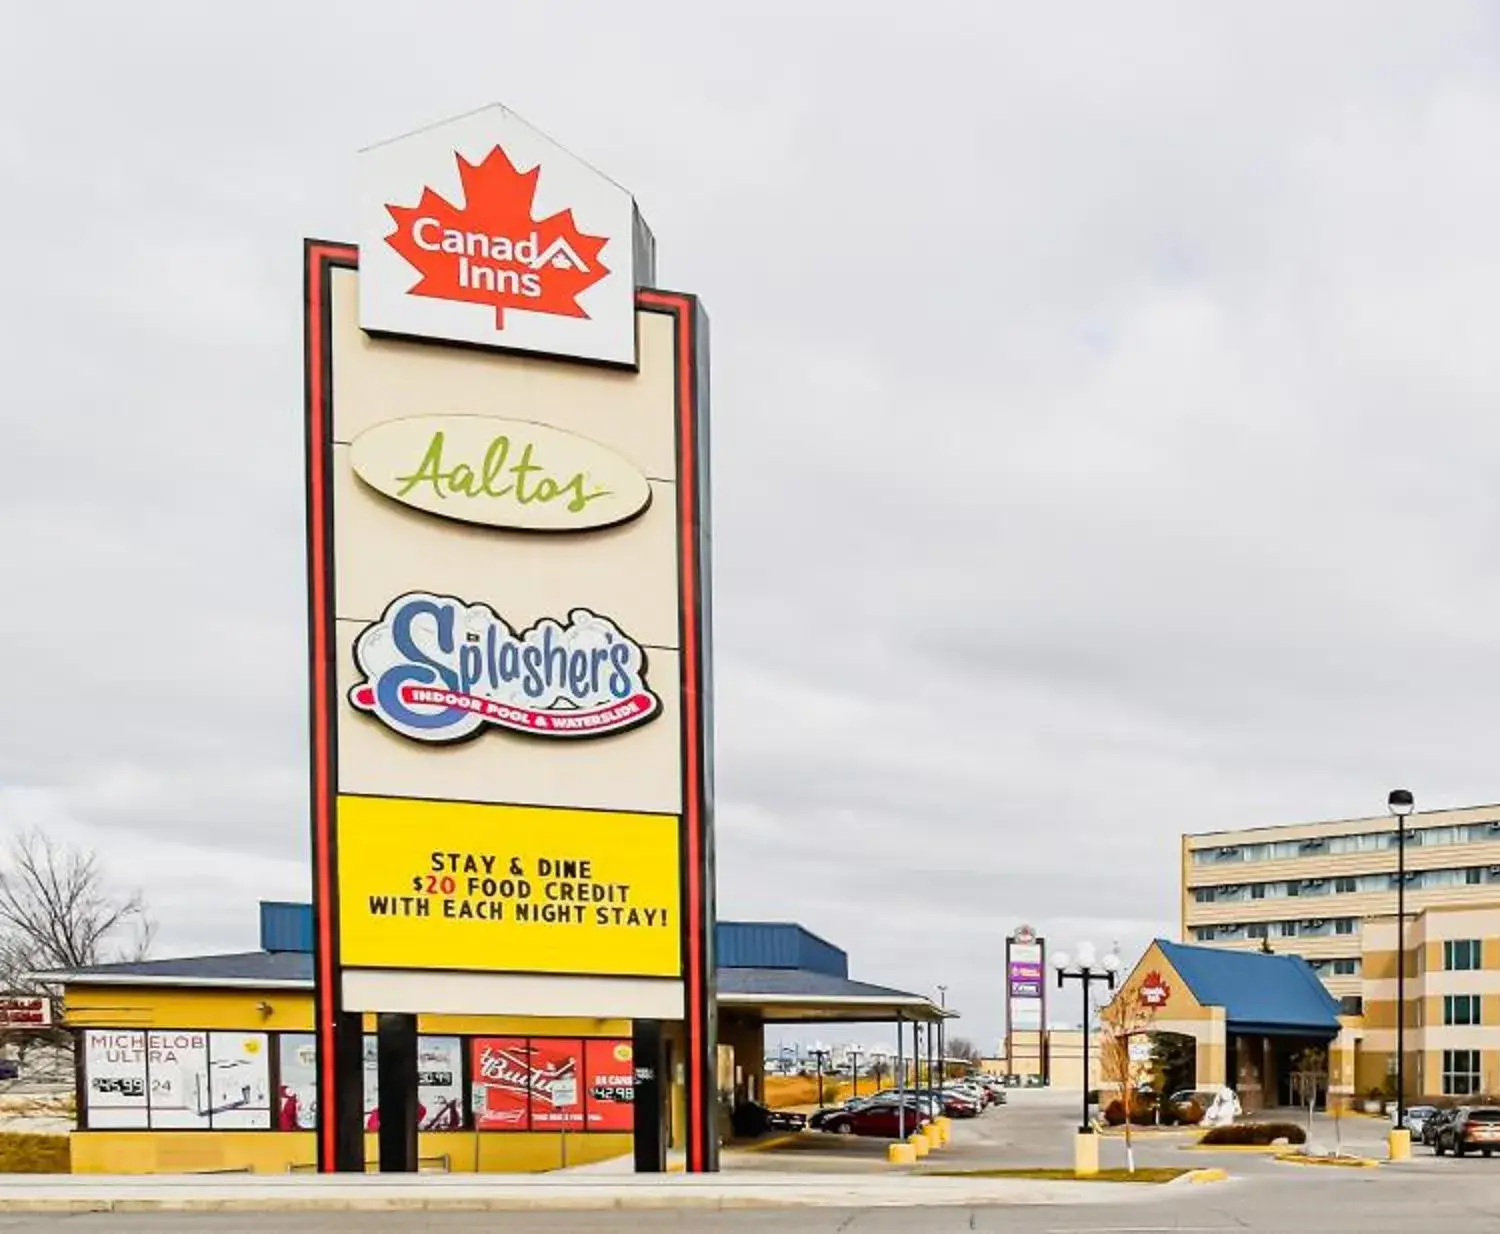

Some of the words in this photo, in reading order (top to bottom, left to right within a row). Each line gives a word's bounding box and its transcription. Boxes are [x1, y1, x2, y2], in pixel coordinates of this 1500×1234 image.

[459, 257, 541, 297] Inns
[396, 432, 613, 513] Aaltos
[377, 600, 632, 729] Splasher's
[413, 690, 482, 711] INDOOR
[487, 704, 530, 726] POOL
[535, 716, 547, 729] &
[552, 703, 642, 729] WATERSLIDE
[431, 852, 496, 876] STAY
[509, 857, 524, 876] &
[538, 858, 591, 879] DINE
[412, 875, 456, 895] $20
[468, 877, 531, 899] FOOD
[545, 882, 630, 903] CREDIT
[369, 896, 430, 917] WITH
[443, 899, 503, 921] EACH
[515, 904, 587, 924] NIGHT
[596, 907, 668, 927] STAY!
[91, 1035, 205, 1049] MICHELOB
[107, 1051, 178, 1063] ULTRA
